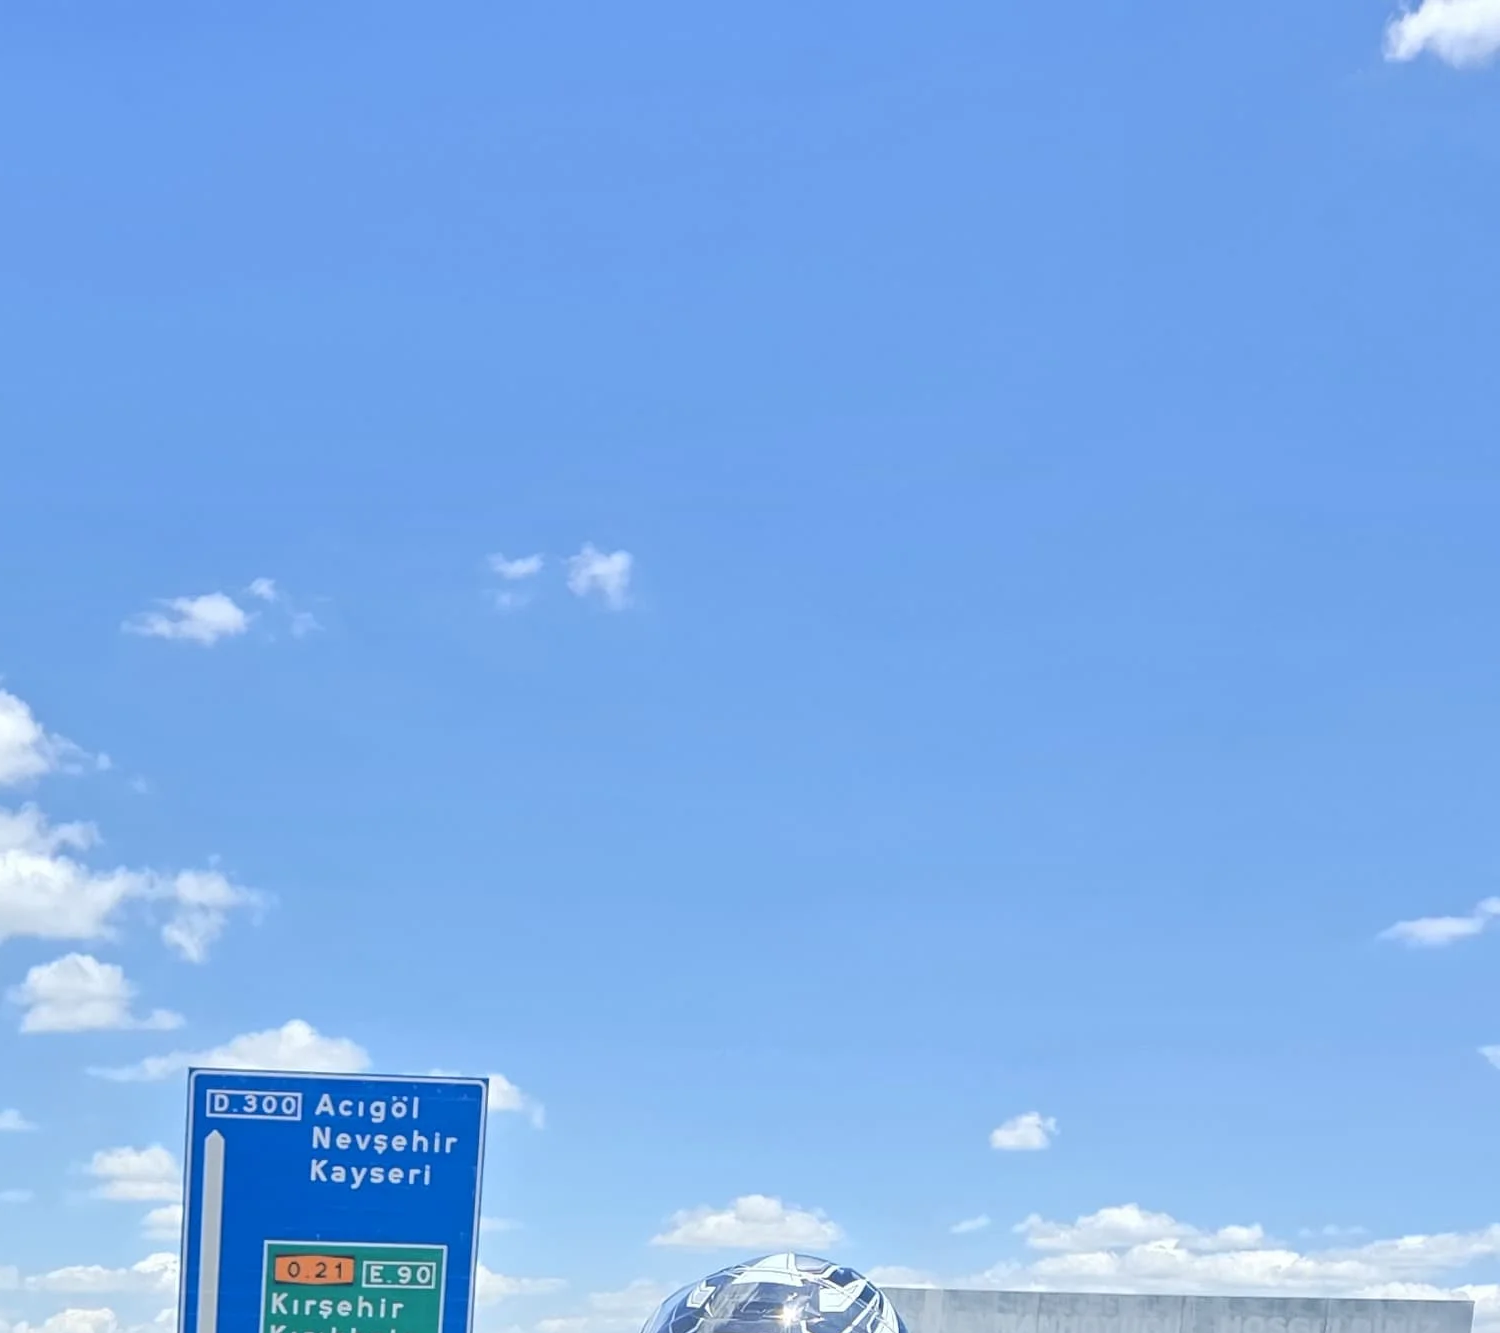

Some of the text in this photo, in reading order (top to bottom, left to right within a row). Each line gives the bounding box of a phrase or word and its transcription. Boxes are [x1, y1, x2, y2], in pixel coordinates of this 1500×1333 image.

[213, 1094, 296, 1115] D.300
[314, 1093, 420, 1123] Acıgöl
[311, 1126, 458, 1155] Nevşehir
[309, 1159, 431, 1189] Kayseri
[369, 1265, 431, 1284] E.90
[271, 1292, 404, 1320] Kırşehir
